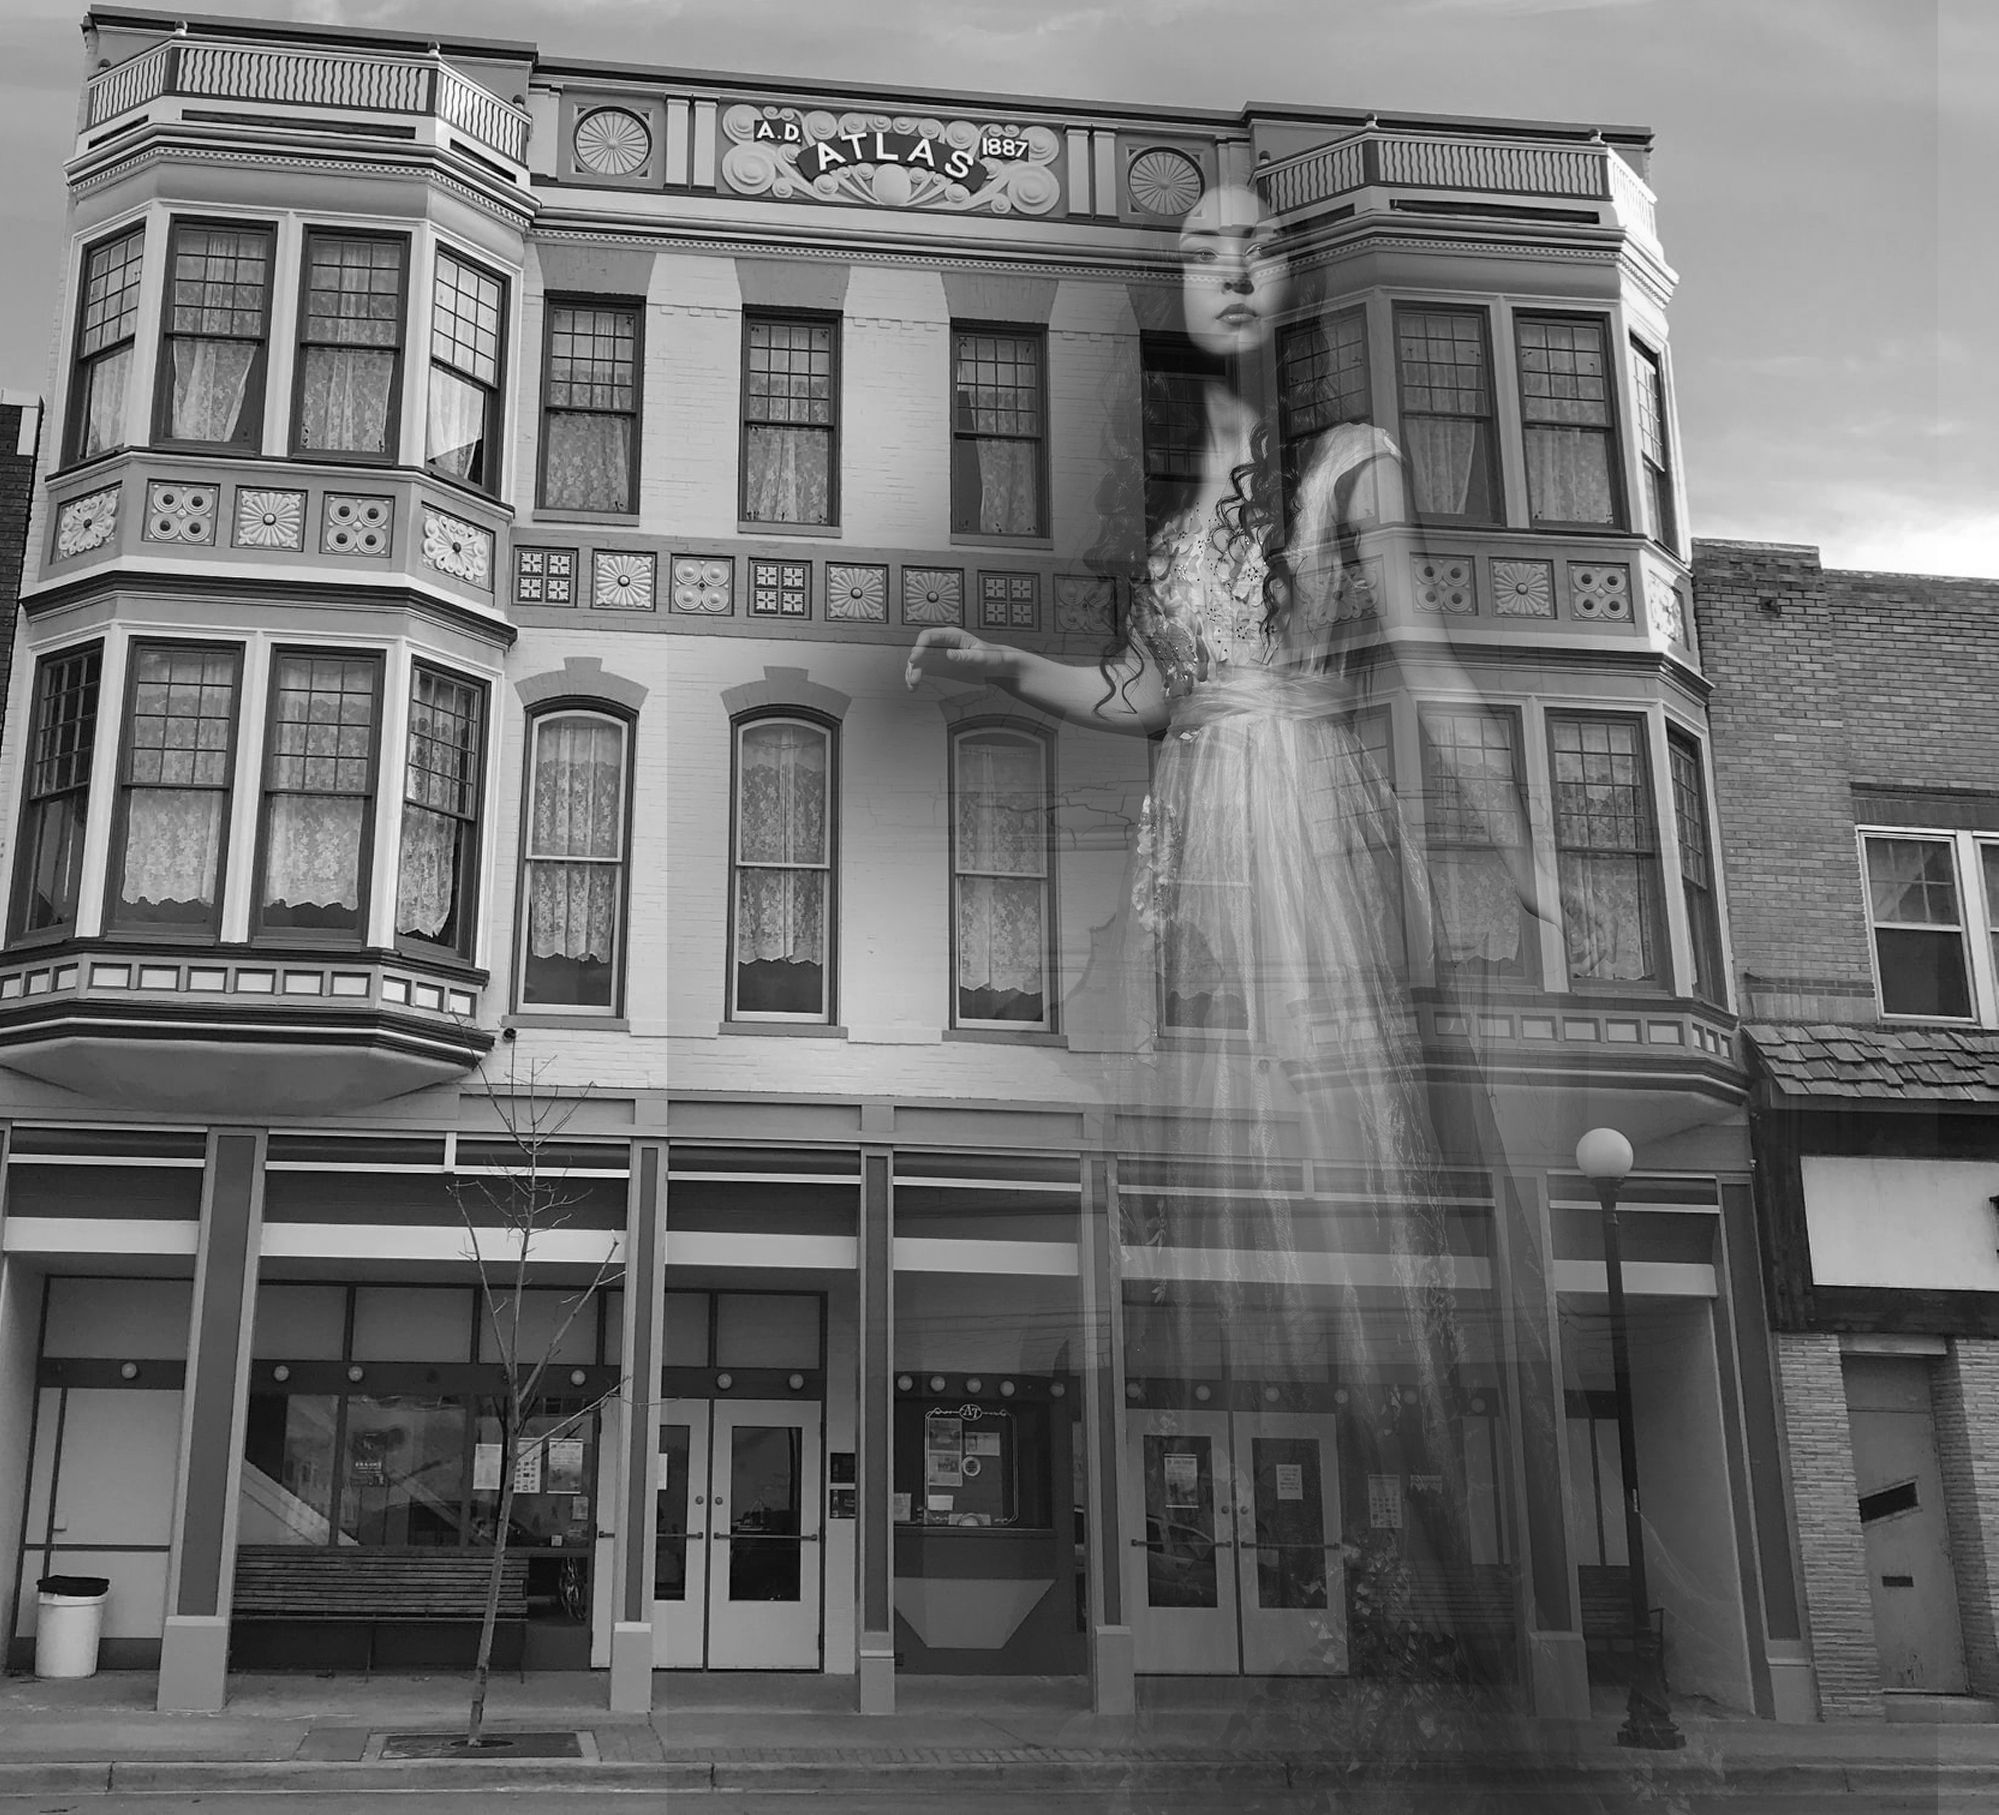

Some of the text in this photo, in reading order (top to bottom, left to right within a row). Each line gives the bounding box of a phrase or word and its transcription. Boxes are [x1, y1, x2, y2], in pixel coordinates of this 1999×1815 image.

[757, 121, 801, 142] A.D.
[816, 131, 974, 178] ATLAS
[982, 137, 1029, 158] 1887
